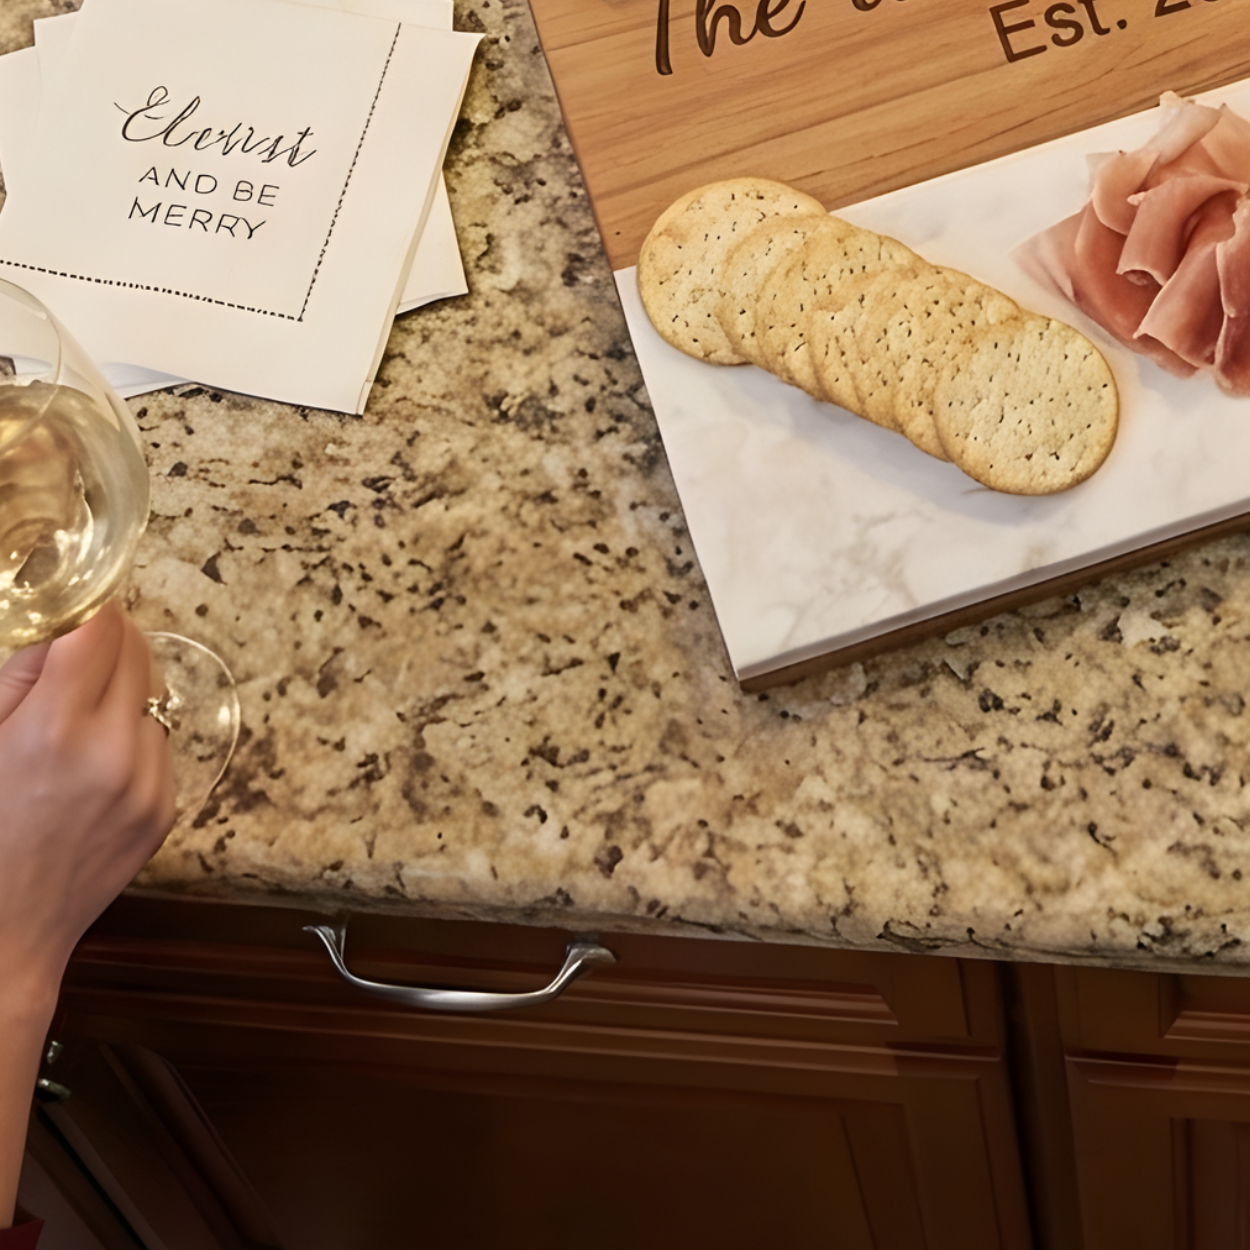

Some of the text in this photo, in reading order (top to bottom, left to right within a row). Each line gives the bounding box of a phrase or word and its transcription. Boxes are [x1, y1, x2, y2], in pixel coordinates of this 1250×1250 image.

[138, 166, 280, 207] AND BE
[127, 196, 267, 240] MERRY
